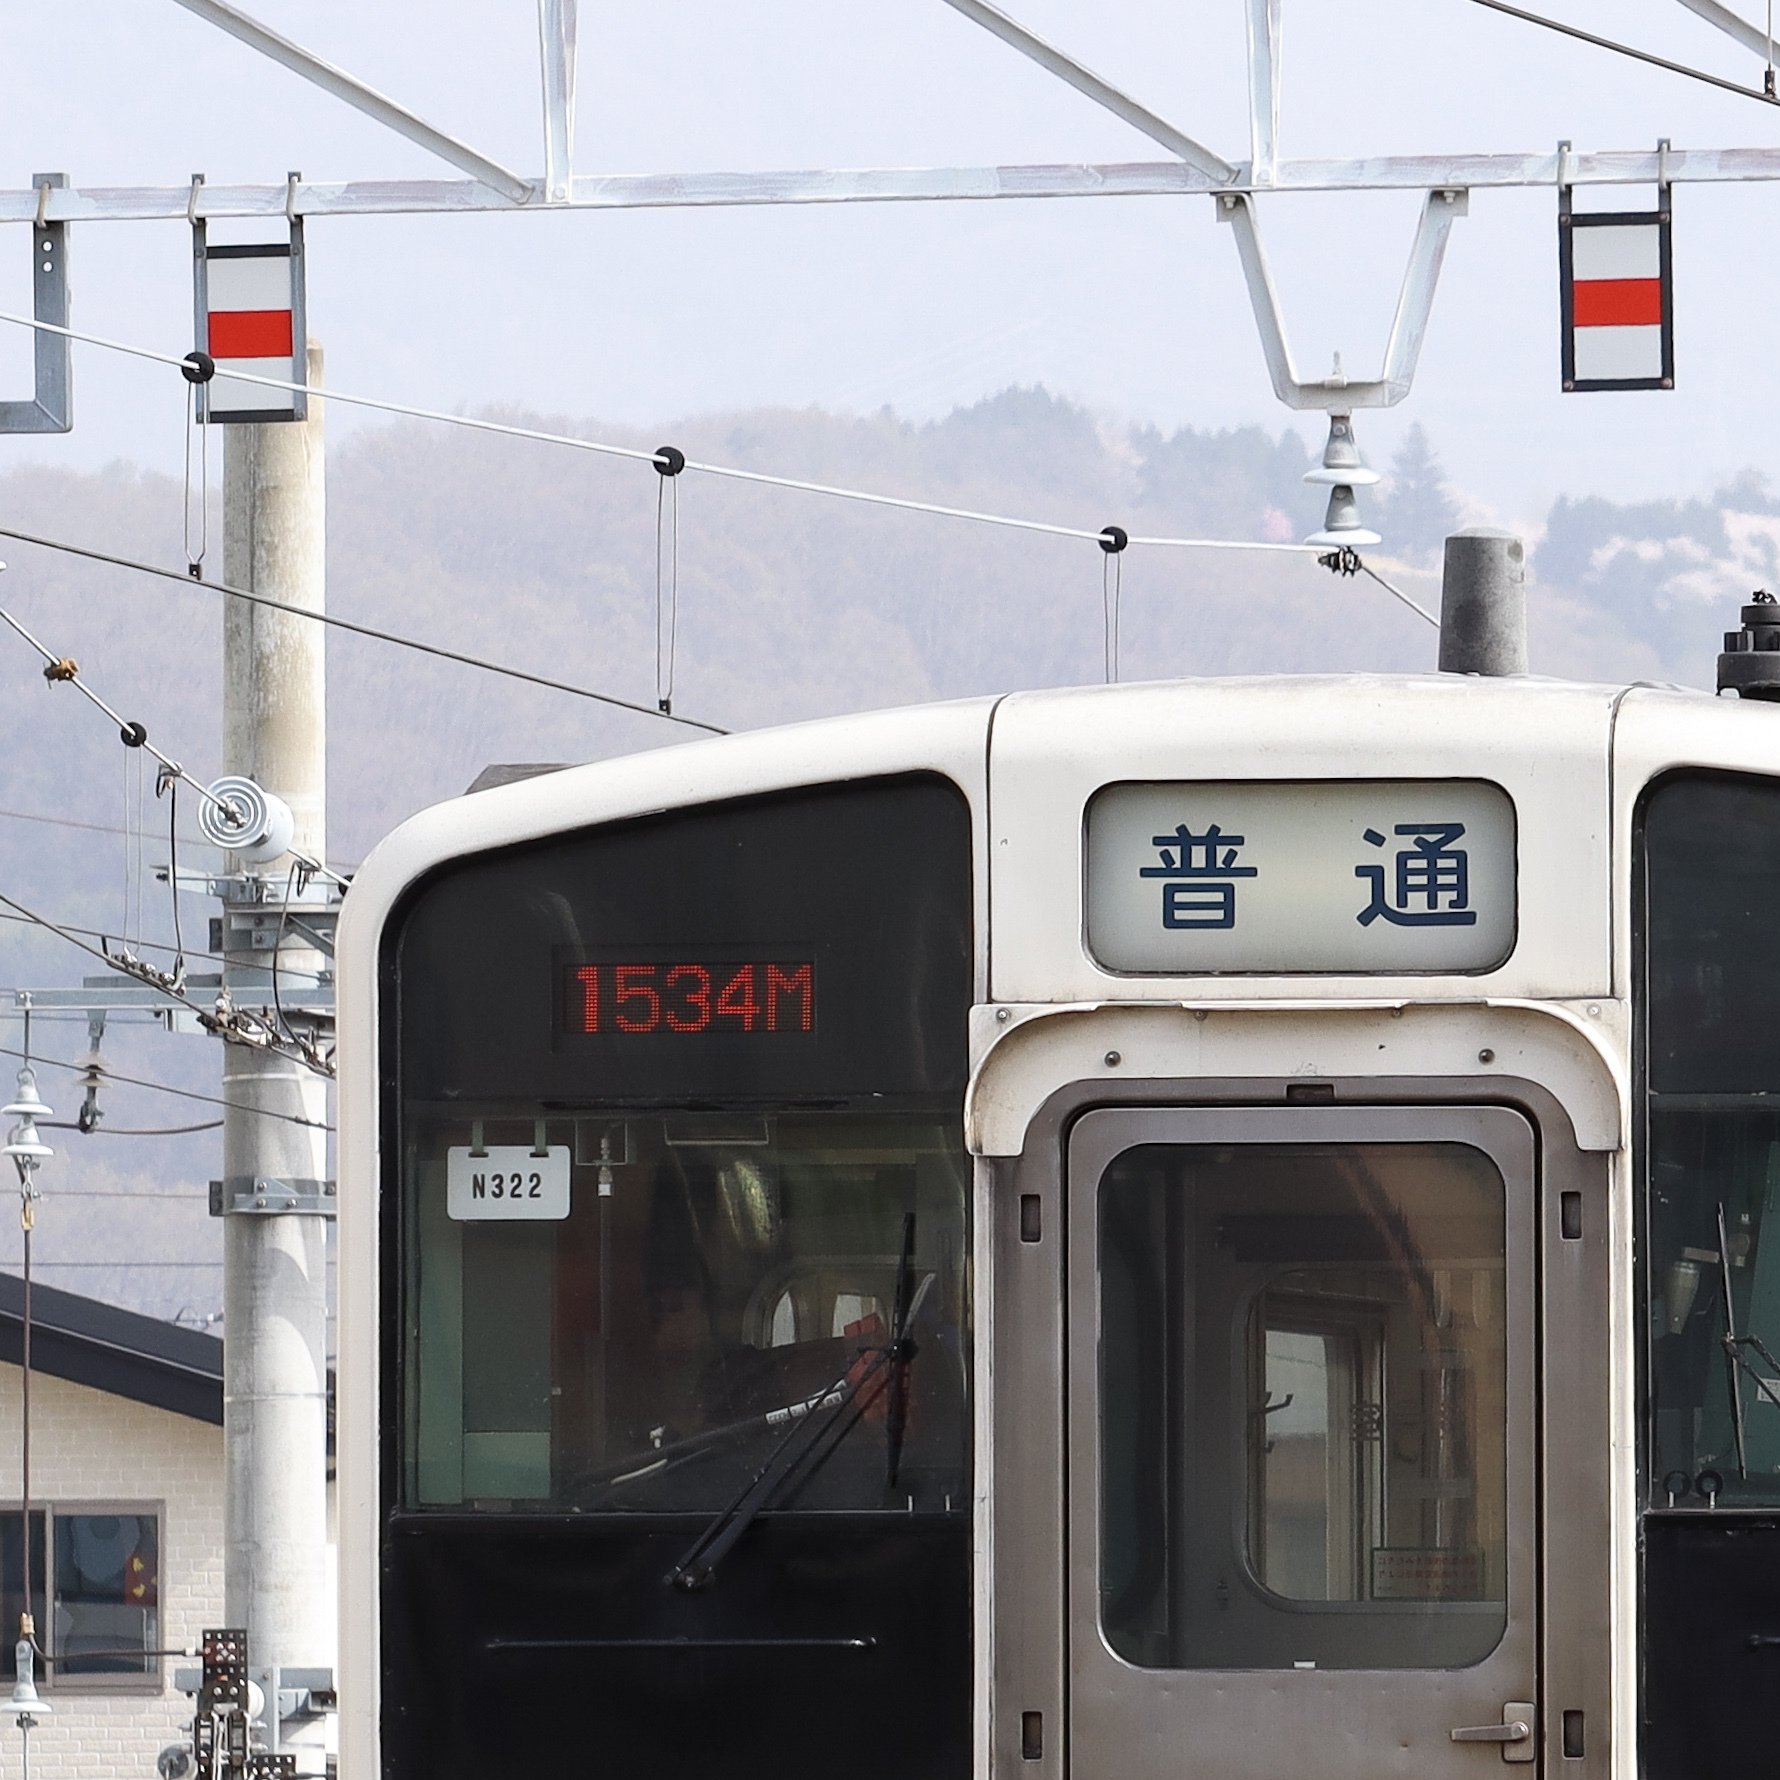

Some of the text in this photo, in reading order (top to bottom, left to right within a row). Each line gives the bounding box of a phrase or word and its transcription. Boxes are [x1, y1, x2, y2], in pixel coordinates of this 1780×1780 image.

[1139, 822, 1477, 930] 普通
[576, 964, 815, 1034] 1534M
[472, 1173, 543, 1199] N322
